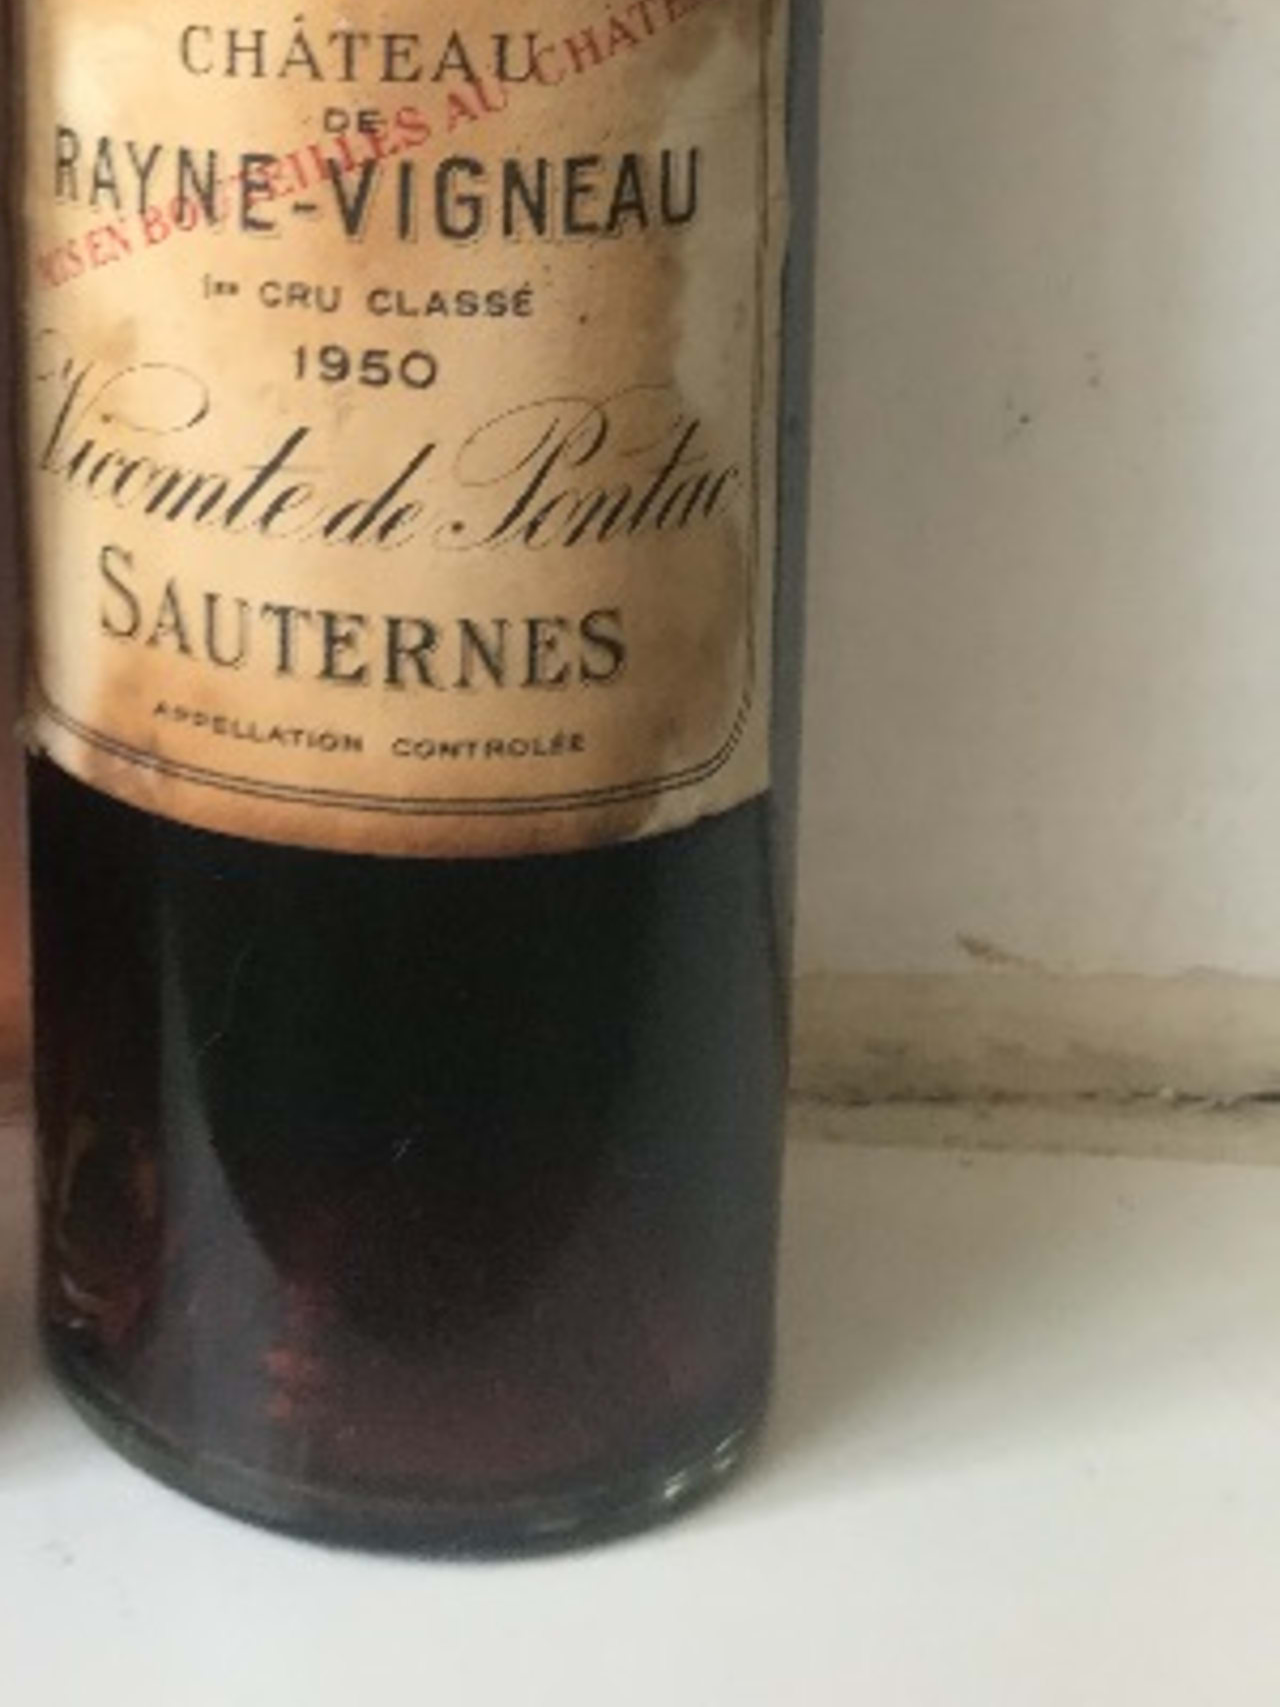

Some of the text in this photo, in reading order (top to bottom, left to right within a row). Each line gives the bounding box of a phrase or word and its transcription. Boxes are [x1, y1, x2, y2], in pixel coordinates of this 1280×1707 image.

[323, 107, 382, 135] DE
[447, 68, 508, 133] AU
[55, 125, 700, 242] RAYNE-VIGNEAU
[259, 280, 341, 314] CRU
[367, 280, 535, 318] CLASSÉ
[293, 344, 438, 390] 1950
[38, 354, 740, 552] Vicomte de Pontac
[100, 543, 627, 692] SAUTERNES
[152, 702, 365, 754] APPELLATION
